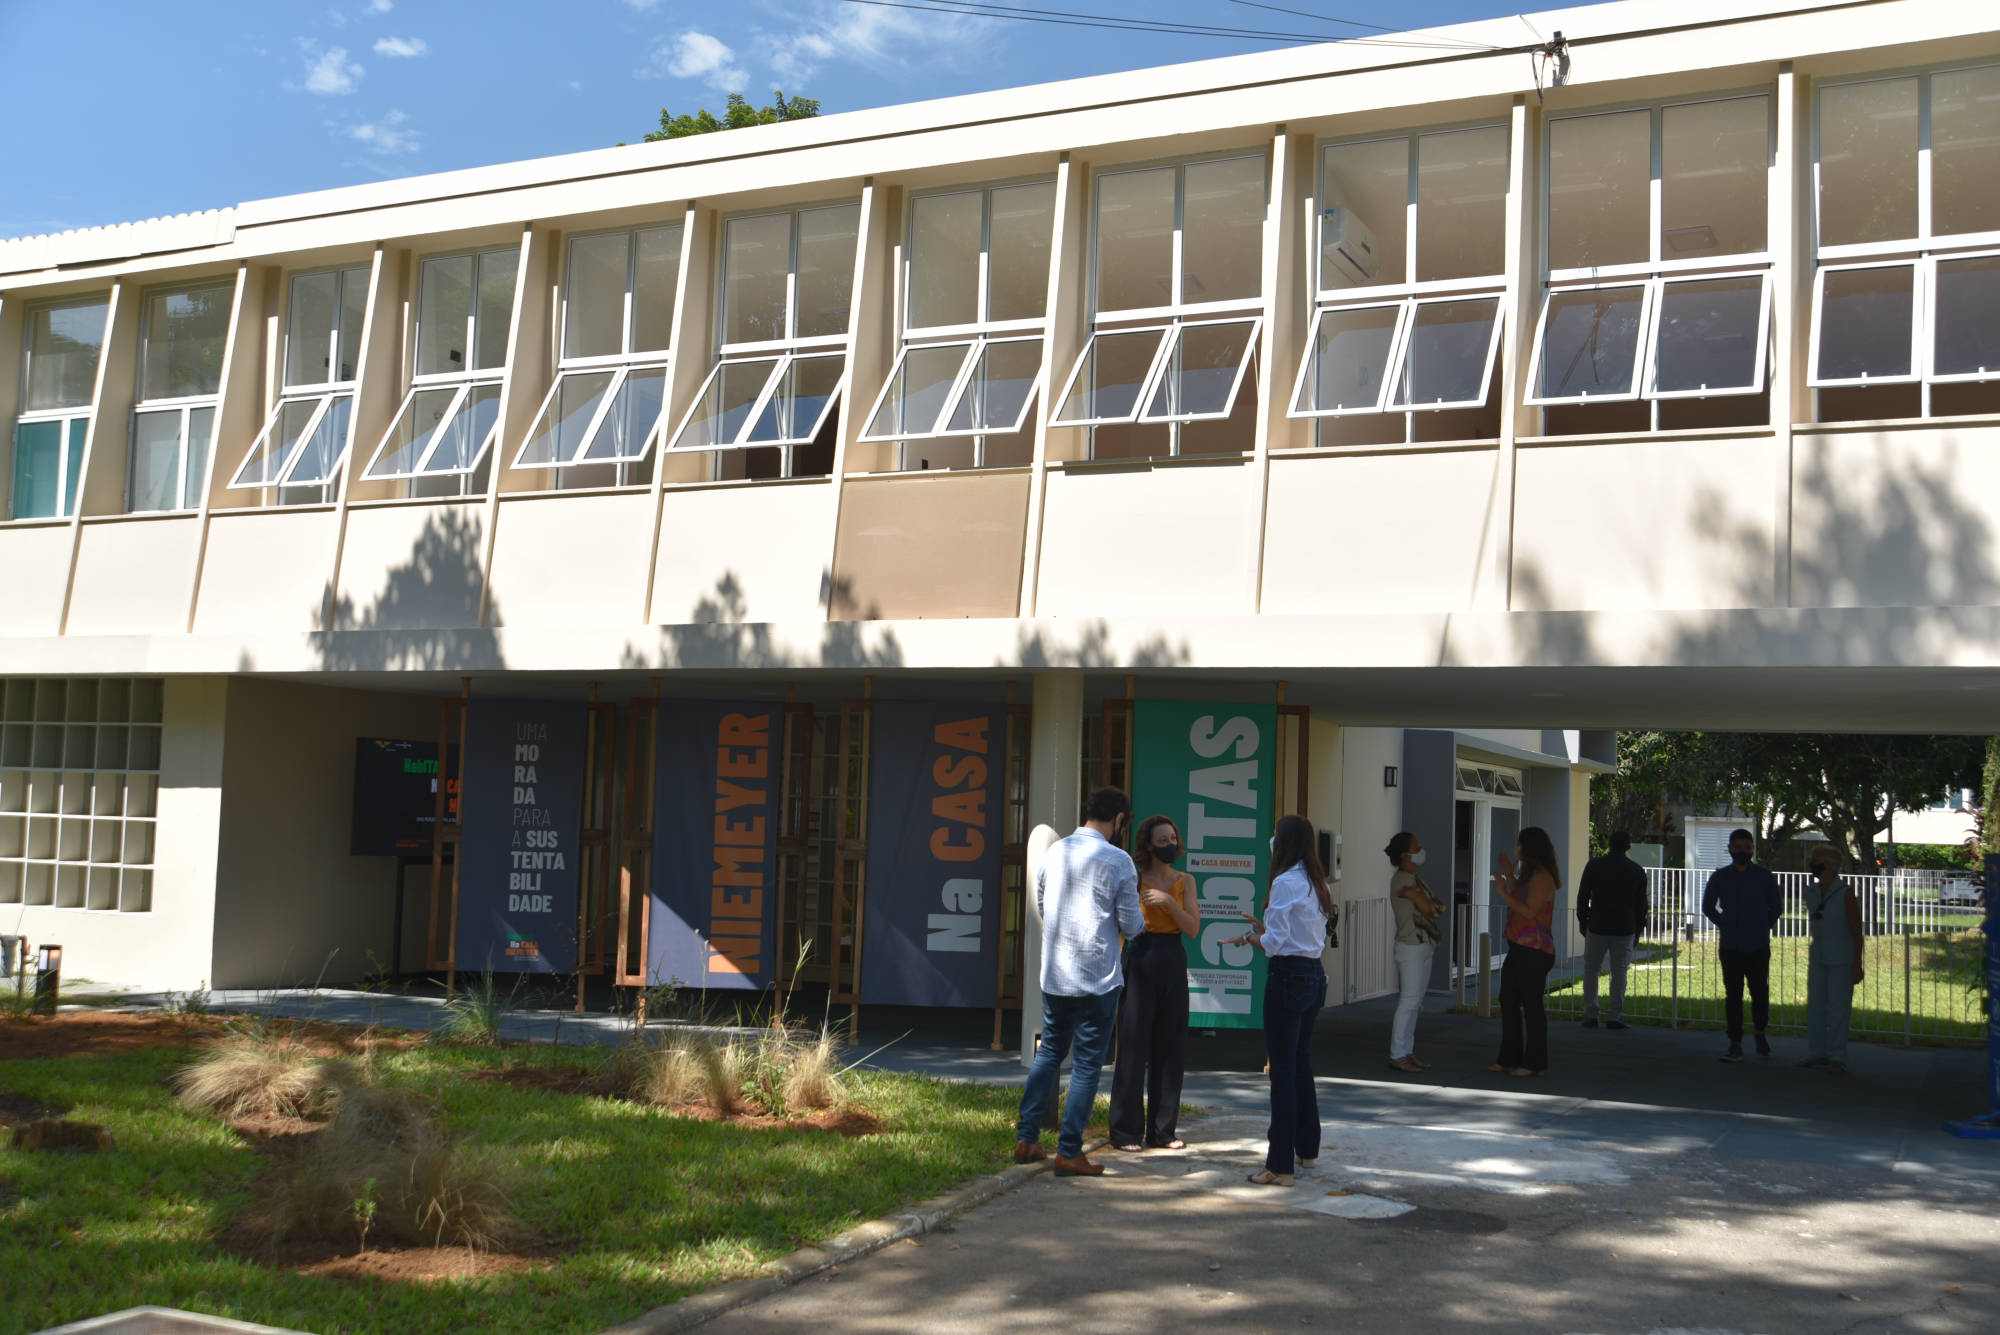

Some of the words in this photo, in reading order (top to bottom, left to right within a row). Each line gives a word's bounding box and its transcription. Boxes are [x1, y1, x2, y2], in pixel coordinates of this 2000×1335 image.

[516, 722, 548, 741] UMA
[515, 744, 539, 762] MO
[514, 765, 537, 783] RA
[513, 787, 536, 805] DA
[930, 716, 990, 862] CASA
[513, 808, 551, 826] PARA
[512, 830, 521, 847] A
[526, 830, 558, 848] SUS
[708, 713, 771, 975] NIEMEYER
[511, 851, 565, 870] TENTA
[510, 873, 541, 891] BILI
[508, 894, 553, 913] DADE
[926, 878, 983, 953] Na
